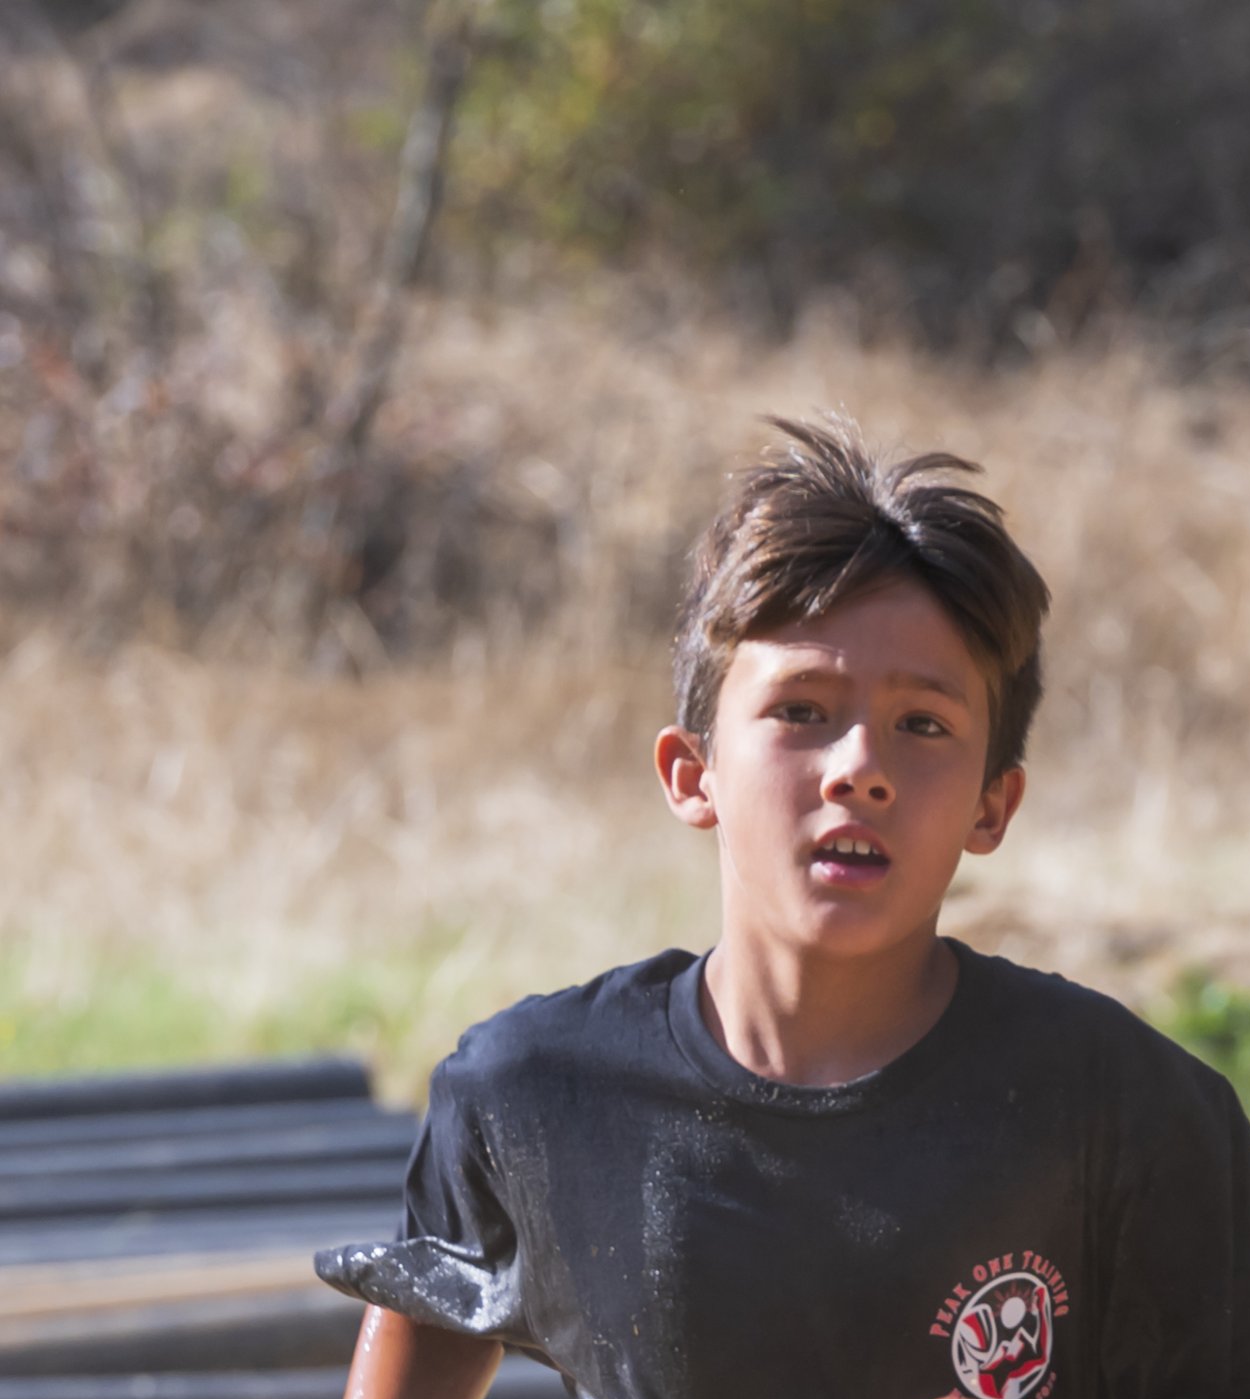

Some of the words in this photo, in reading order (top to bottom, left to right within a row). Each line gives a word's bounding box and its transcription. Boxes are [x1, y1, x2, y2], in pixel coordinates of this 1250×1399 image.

[929, 1282, 972, 1338] PEAK
[973, 1253, 1014, 1282] ONE
[1021, 1250, 1069, 1318] TRAINING
